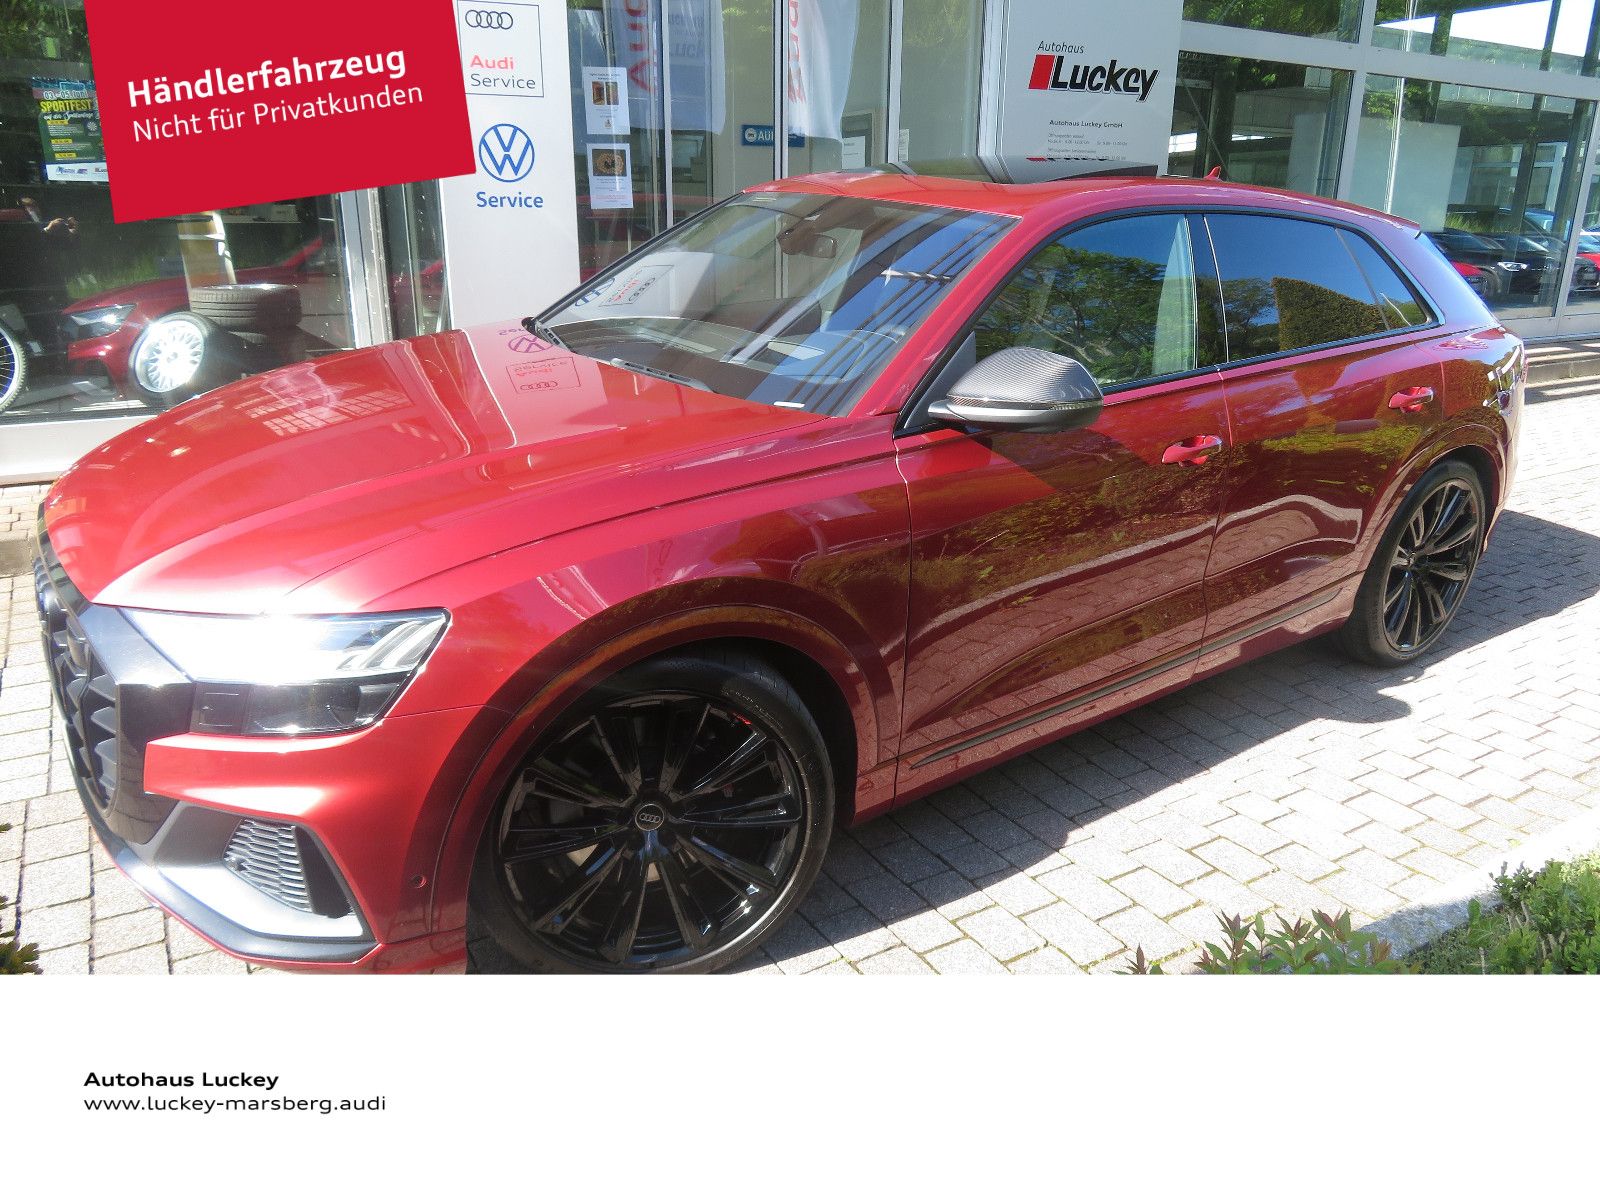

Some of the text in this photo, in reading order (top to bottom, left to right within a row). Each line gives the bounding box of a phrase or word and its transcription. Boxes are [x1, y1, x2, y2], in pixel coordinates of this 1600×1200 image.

[1037, 40, 1085, 54] Autohaus
[470, 54, 515, 70] Audi
[470, 73, 536, 89] Service
[1050, 55, 1159, 102] Luckey
[40, 99, 92, 113] SPORTFEST
[476, 191, 544, 209] Service
